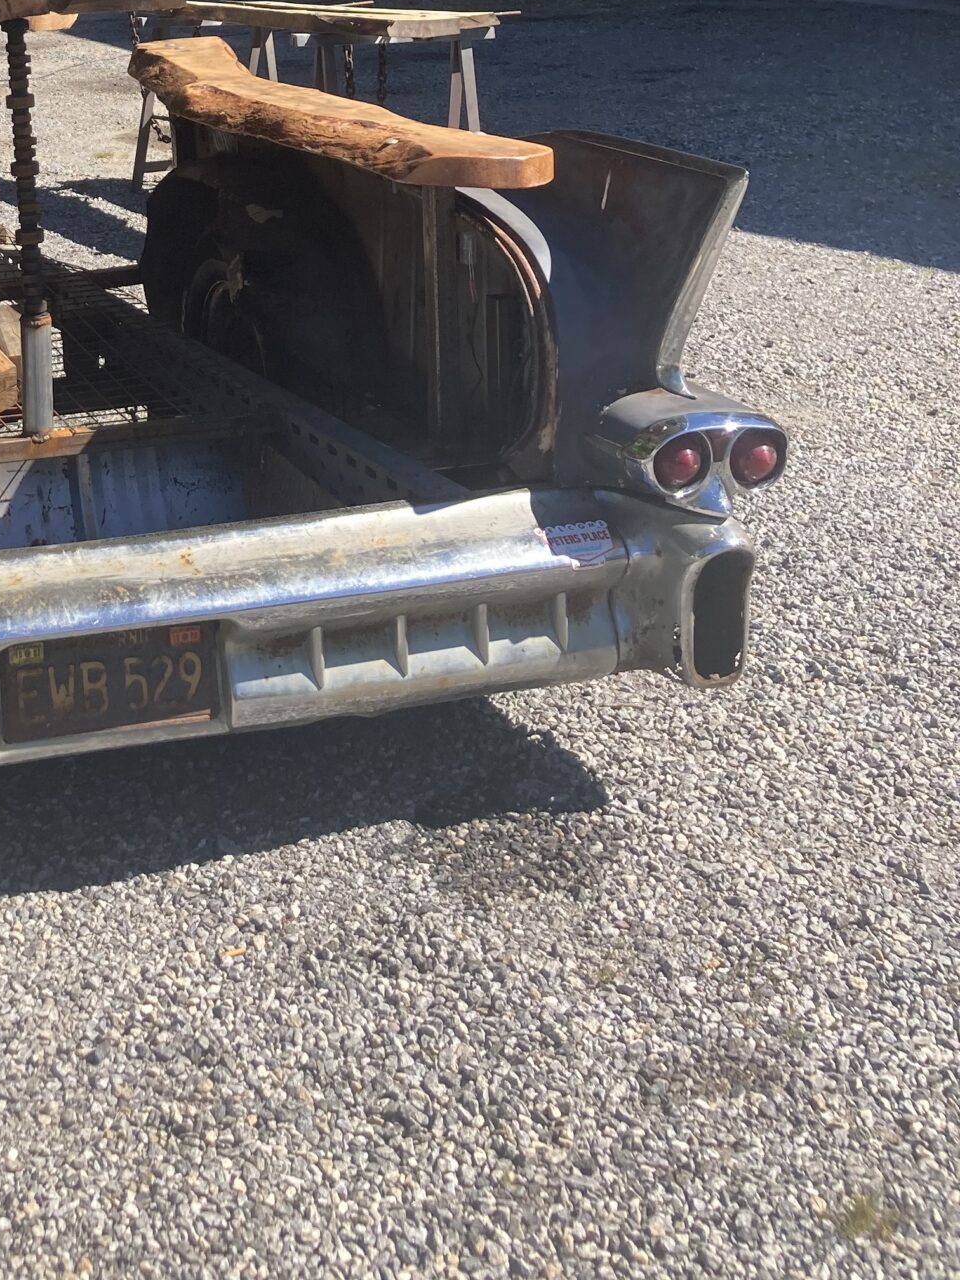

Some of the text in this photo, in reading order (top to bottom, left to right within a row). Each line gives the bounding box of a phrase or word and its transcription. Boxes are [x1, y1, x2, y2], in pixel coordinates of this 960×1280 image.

[548, 530, 610, 547] PETERS PLACE
[123, 651, 203, 711] 529
